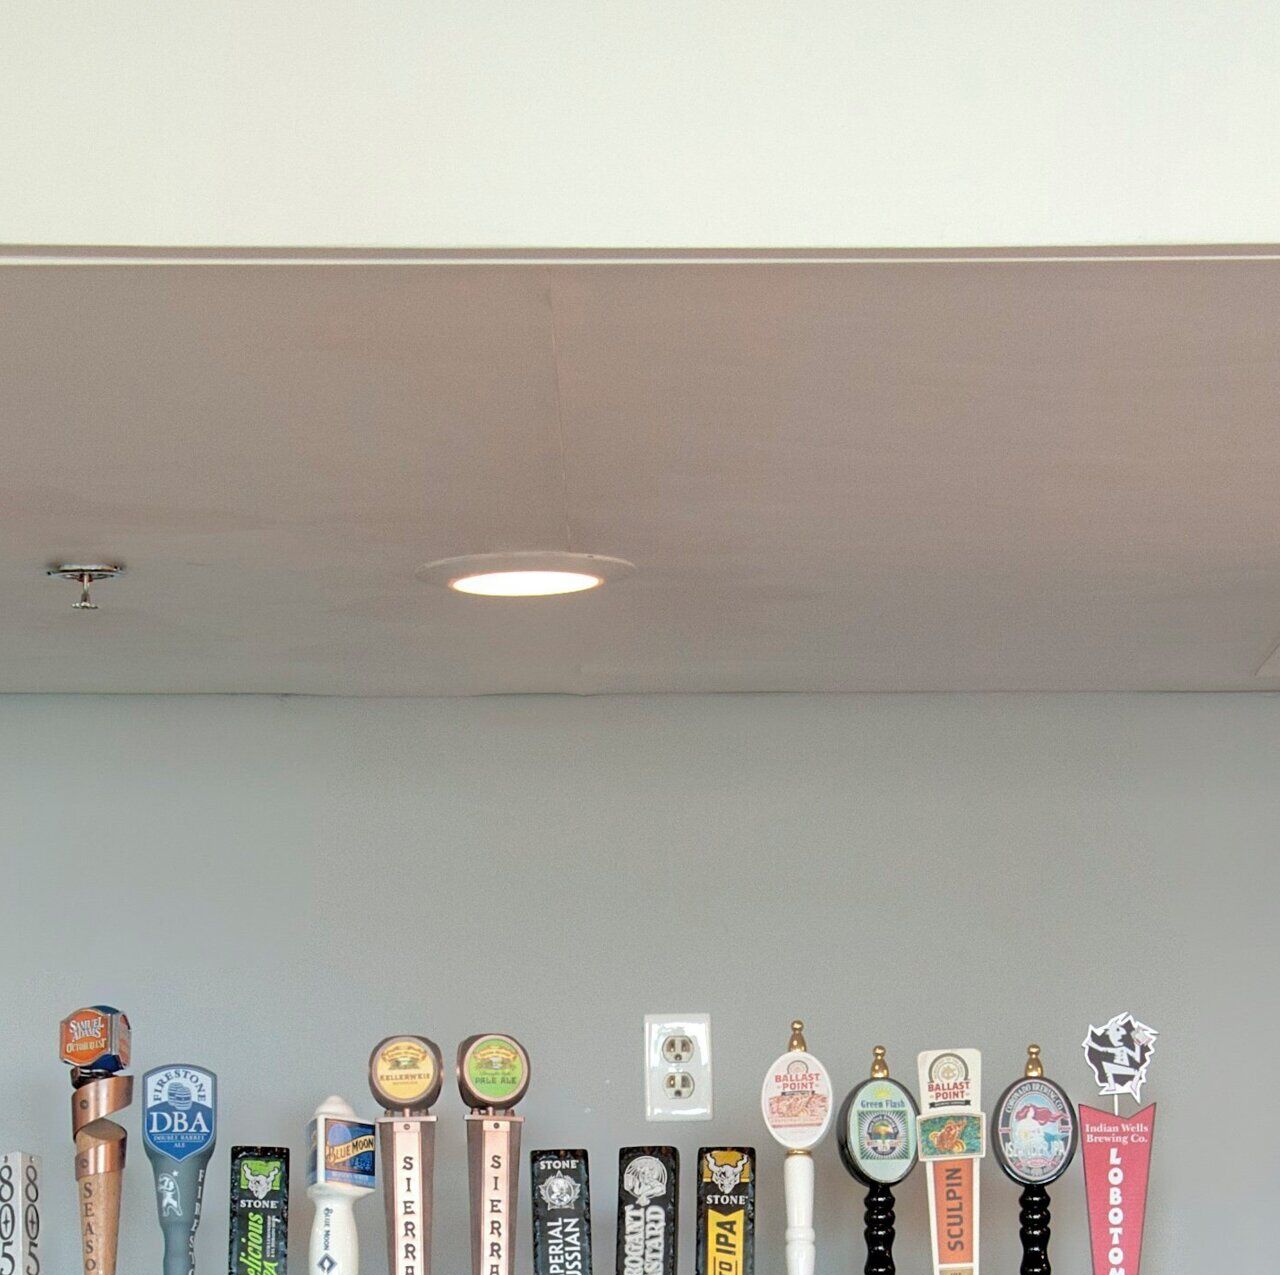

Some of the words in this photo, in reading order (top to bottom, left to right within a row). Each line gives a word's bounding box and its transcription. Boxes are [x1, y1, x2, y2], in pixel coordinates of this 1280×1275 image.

[775, 1073, 820, 1082] BALLAST
[153, 1069, 206, 1101] FIRESTONE
[783, 1082, 814, 1090] POINT
[928, 1081, 970, 1092] BALLAST
[935, 1090, 965, 1100] POINT
[861, 1100, 883, 1108] Green
[885, 1099, 906, 1108] Flash
[149, 1111, 210, 1133] DBA
[1085, 1124, 1119, 1133] Indian
[1121, 1124, 1148, 1133] Wells
[1086, 1134, 1128, 1145] Brewing
[1131, 1134, 1148, 1143] Co.
[327, 1145, 352, 1163] BLUE
[352, 1137, 374, 1153] MOON
[539, 1160, 577, 1170] STONE
[240, 1200, 278, 1209] STONE
[707, 1195, 745, 1205] STONE
[945, 1167, 964, 1251] SCULPIN
[324, 1208, 333, 1227] BLUE
[716, 1220, 737, 1255] IPA
